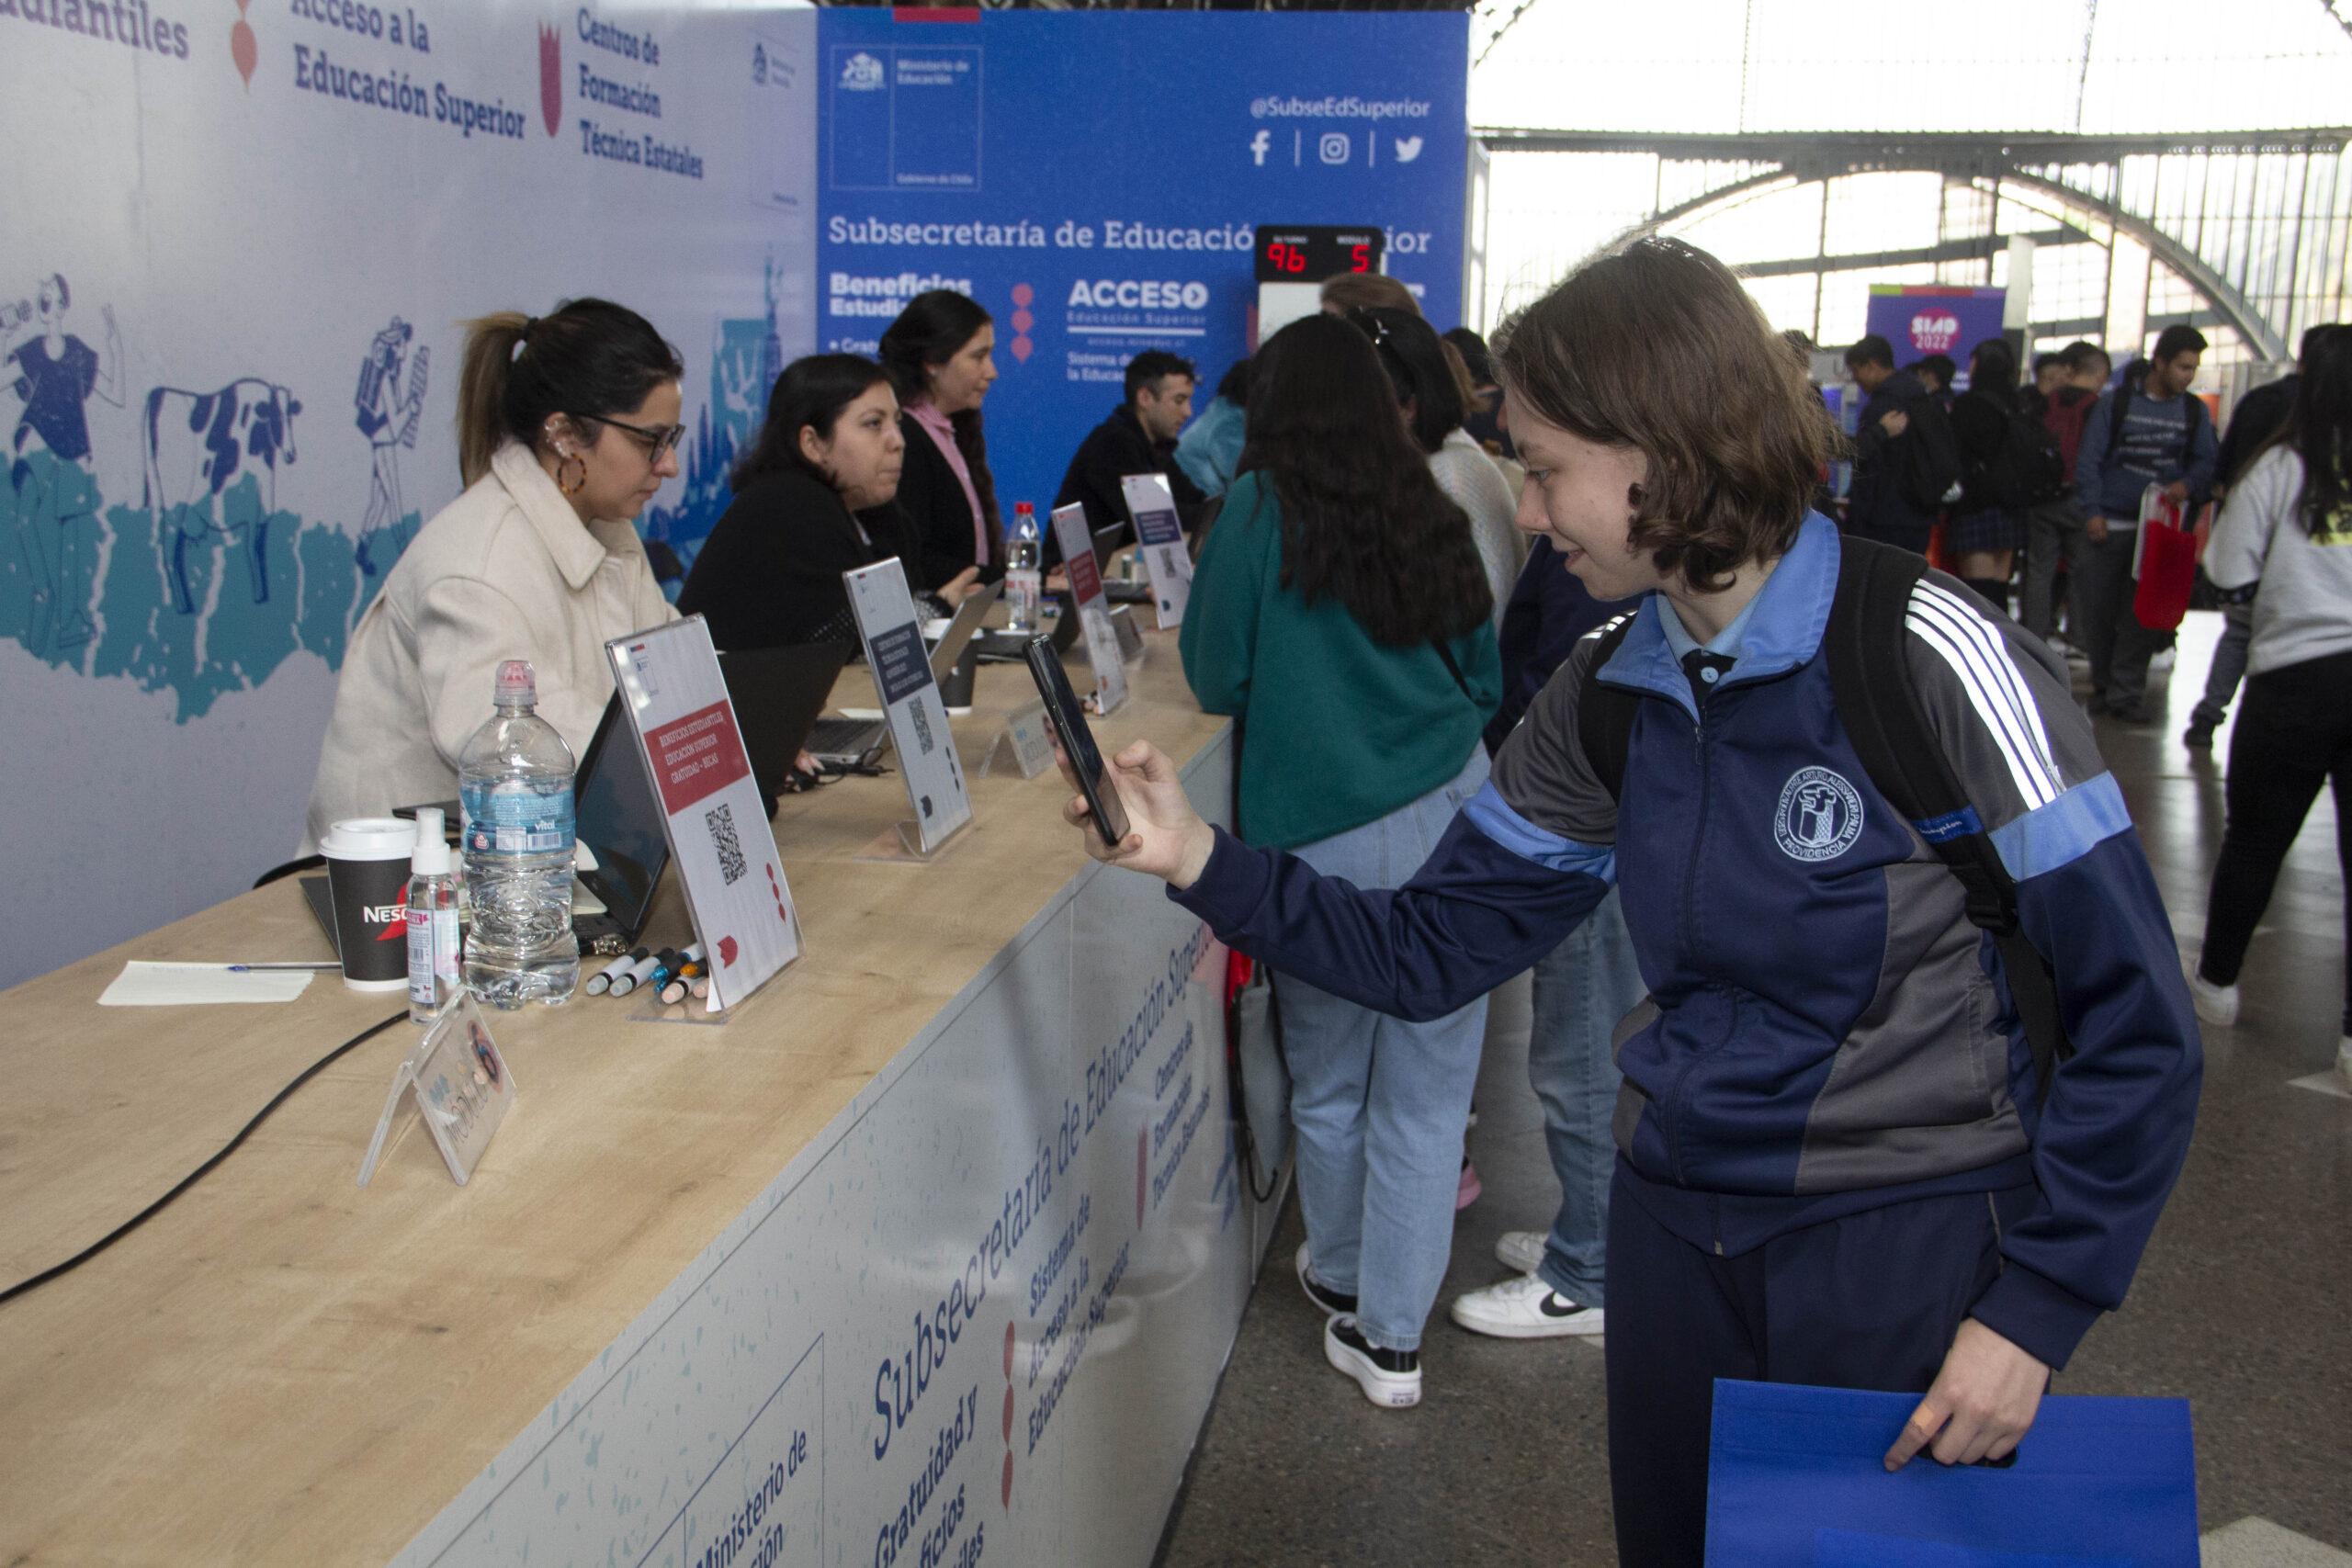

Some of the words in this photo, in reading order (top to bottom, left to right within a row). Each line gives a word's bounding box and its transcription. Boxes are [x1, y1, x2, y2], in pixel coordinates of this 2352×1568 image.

[390, 12, 402, 45] a
[408, 7, 430, 53] la
[577, 7, 639, 61] Centros
[643, 31, 660, 66] de
[293, 42, 429, 118] Educación
[435, 81, 526, 139] Superior
[579, 62, 662, 118] Formación
[1250, 96, 1431, 121] @SubseEdSuperior
[580, 118, 641, 164] Técnica
[644, 135, 704, 180] Estatales
[829, 216, 1046, 247] Subsecretaría
[1055, 220, 1095, 248] de
[1103, 220, 1255, 251] Educació
[1268, 243, 1306, 273] 96
[1351, 244, 1371, 273] 5
[830, 272, 973, 297] Beneficios
[1068, 279, 1209, 310] ACCESO
[1916, 333, 1949, 350] 2022
[535, 819, 556, 831] vital
[1802, 771, 1828, 782] ARTURO
[1841, 813, 1860, 840] PALMA
[1782, 837, 1847, 859] PROVIDENCIA
[363, 904, 408, 924] NESC
[875, 1137, 1053, 1461] Subsecretaría
[1058, 1100, 1080, 1176] de
[1085, 976, 1165, 1135] Educación
[1030, 1220, 1075, 1317] Sistema
[1077, 1193, 1091, 1236] de
[1029, 1293, 1069, 1389] Acceso
[1070, 1277, 1078, 1311] a
[1079, 1256, 1090, 1292] la
[1028, 1320, 1087, 1457] Educación
[1089, 1241, 1130, 1332] Superior
[788, 1429, 808, 1478] de
[875, 1394, 964, 1568] Gratuidad
[967, 1383, 978, 1443] y
[919, 1483, 965, 1568] ficios
